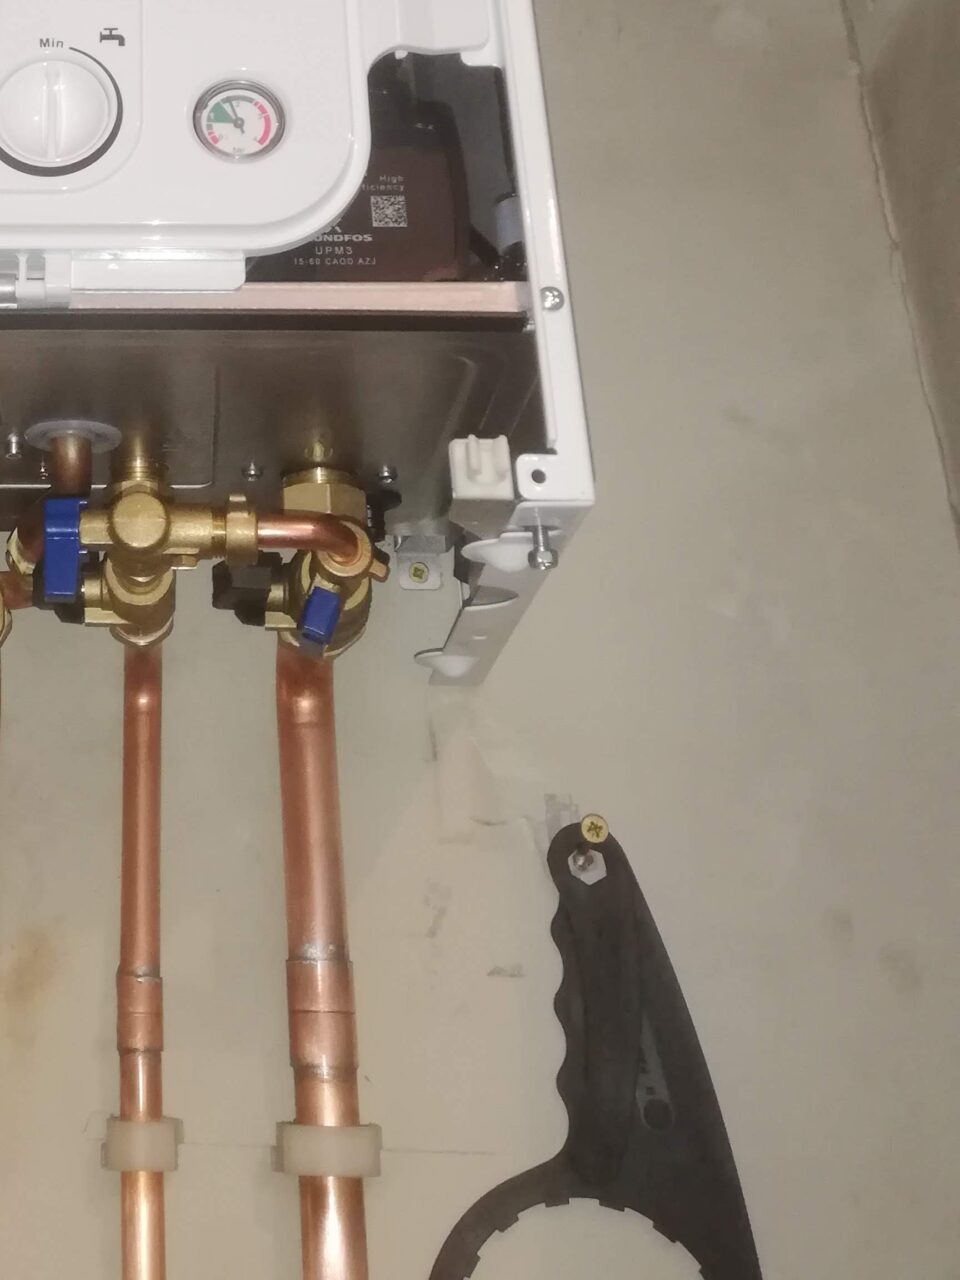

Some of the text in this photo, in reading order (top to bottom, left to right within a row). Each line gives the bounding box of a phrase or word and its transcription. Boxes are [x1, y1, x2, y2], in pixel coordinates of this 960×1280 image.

[40, 38, 64, 48] Min
[379, 174, 404, 184] High
[315, 246, 353, 255] UPM3
